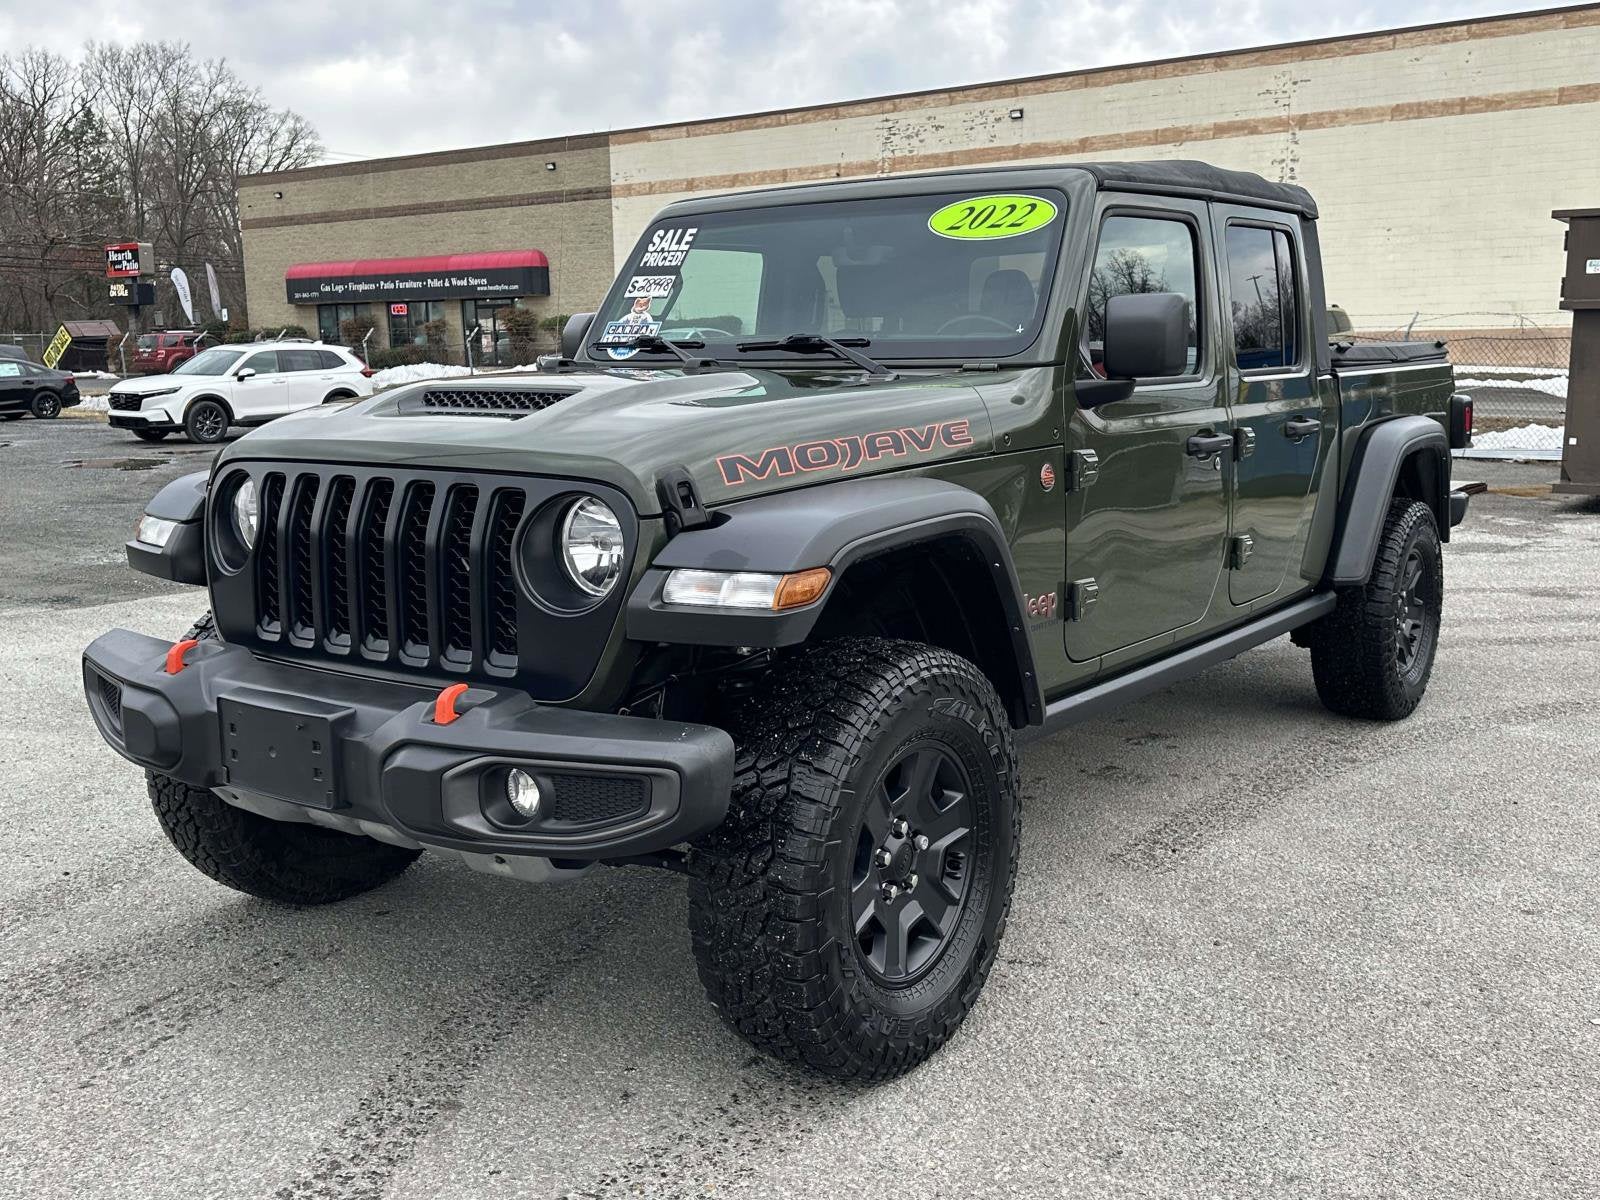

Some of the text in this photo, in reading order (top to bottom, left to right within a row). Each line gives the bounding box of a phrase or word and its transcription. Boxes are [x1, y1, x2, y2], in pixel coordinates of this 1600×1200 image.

[945, 202, 1038, 231] 2022
[647, 227, 698, 252] SALE
[108, 250, 132, 261] Hearth
[639, 250, 687, 267] PRICED!
[122, 259, 139, 271] Patio
[320, 276, 488, 293] Gas Logs Fireplaces Patio Furniture Pellet & Wood Stoves
[608, 325, 656, 335] CARFAX
[716, 420, 975, 486] MOJAVE
